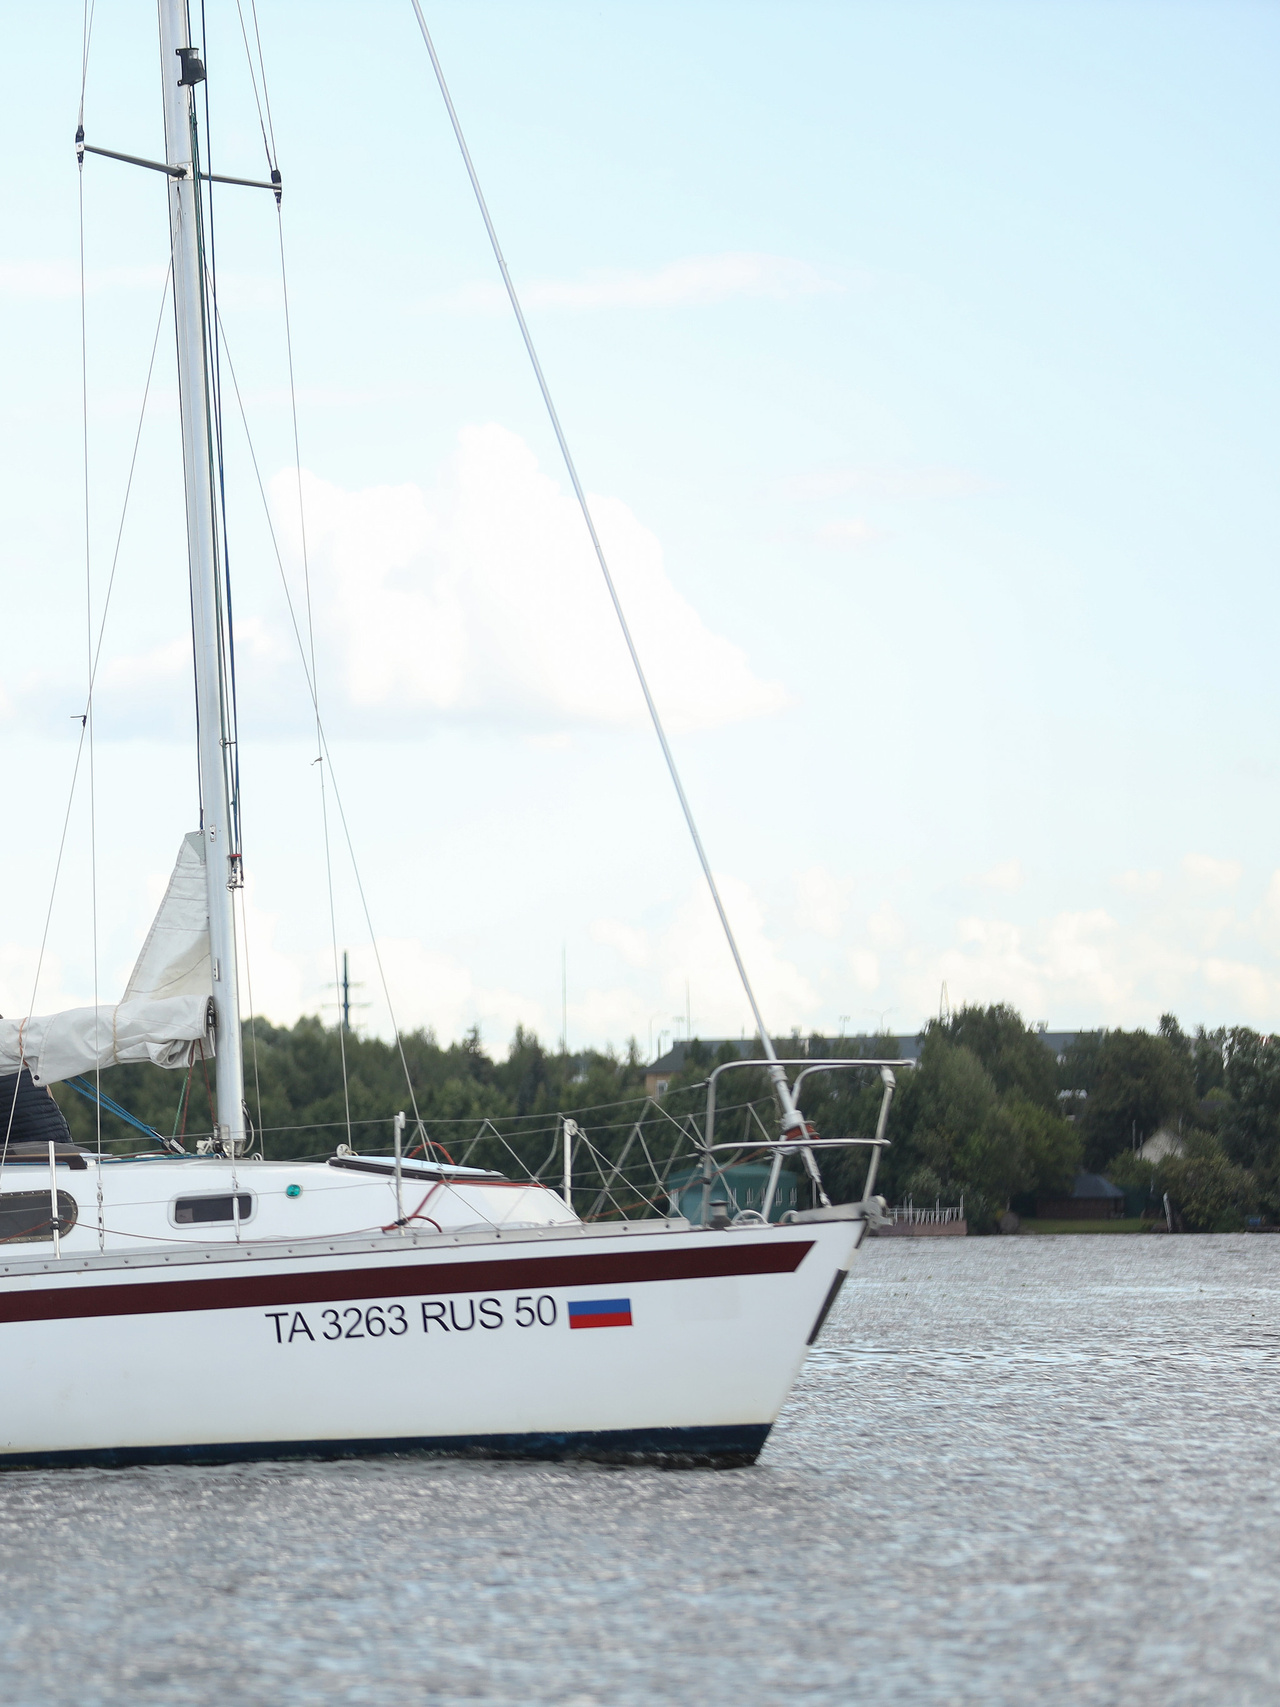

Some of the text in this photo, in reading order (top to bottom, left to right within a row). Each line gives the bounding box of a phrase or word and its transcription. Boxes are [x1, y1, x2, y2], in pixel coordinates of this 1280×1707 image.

[265, 1295, 557, 1344] TA 3263 RUS 50
